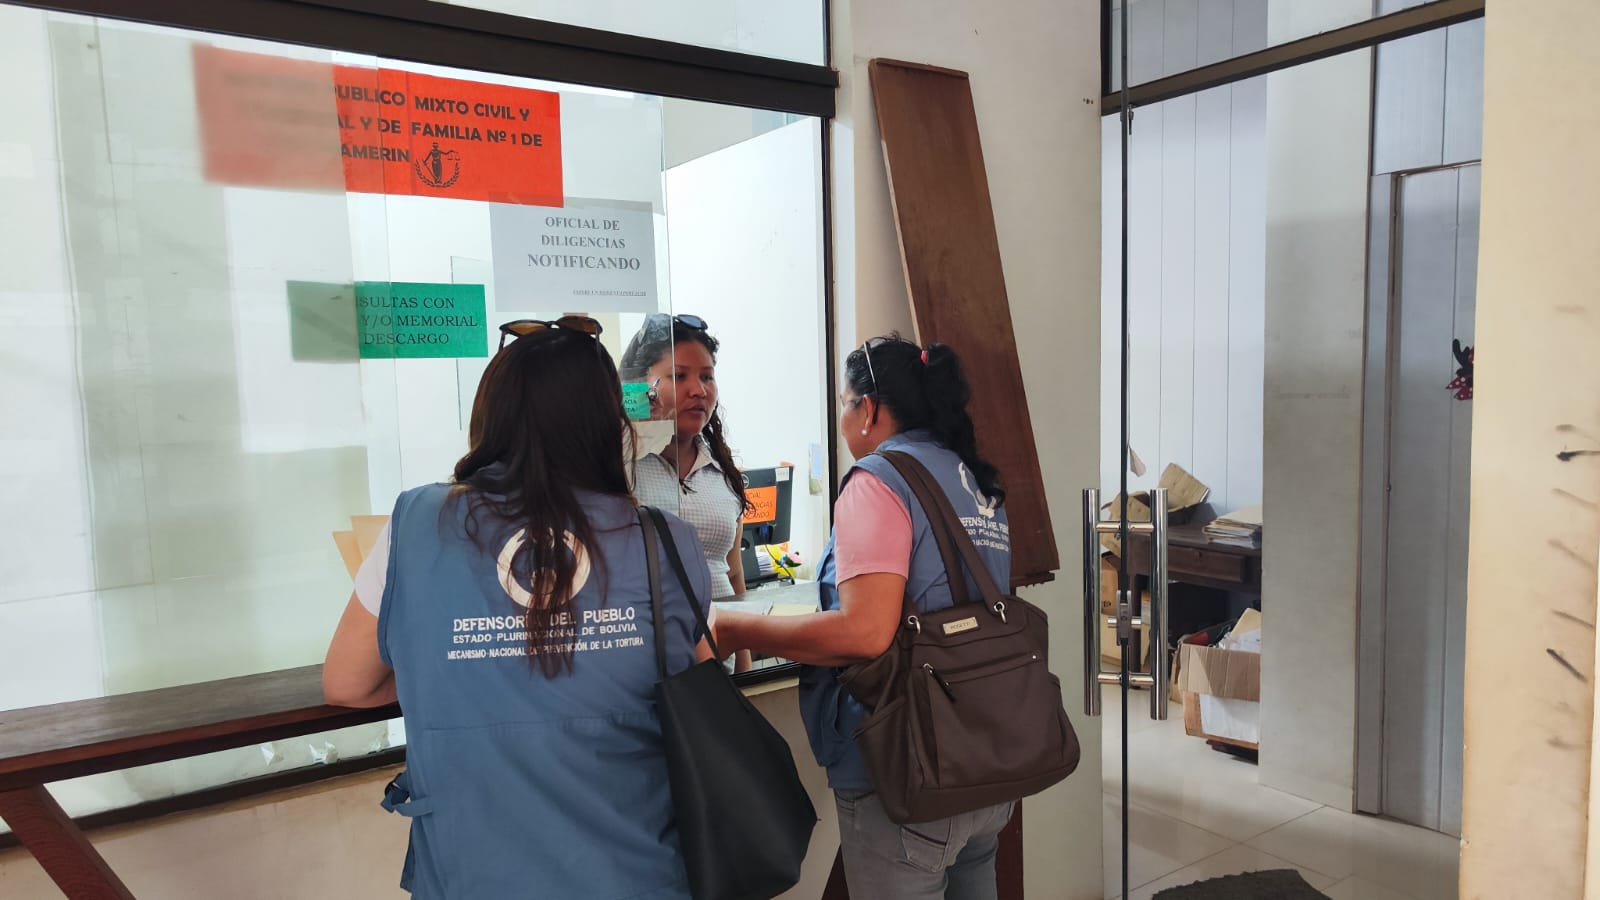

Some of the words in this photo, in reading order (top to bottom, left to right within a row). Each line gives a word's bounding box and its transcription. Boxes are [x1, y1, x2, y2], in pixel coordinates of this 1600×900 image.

[334, 85, 406, 106] UBLICO
[415, 96, 469, 115] MIXTO
[474, 103, 516, 120] CIVIL
[519, 108, 530, 122] Y
[360, 116, 373, 130] Y
[378, 118, 401, 134] DE
[411, 122, 482, 142] FAMILIA
[510, 134, 516, 145] 1
[521, 133, 543, 147] DE
[545, 216, 599, 230] OFICIAL
[603, 219, 621, 231] DE
[541, 234, 626, 249] DILIGENCIAS
[528, 253, 641, 271] NOTIFICANDO
[356, 295, 418, 309] SULTAS
[423, 296, 455, 309] CON
[362, 315, 392, 328] Y/O
[397, 315, 477, 327] MEMORIAL
[364, 333, 449, 345] DESCARGO
[453, 611, 543, 632] DEFENSORÍ
[549, 611, 577, 627] DEL
[583, 606, 635, 624] PUEBLO
[453, 633, 492, 644] ESTADO
[581, 626, 595, 636] DE
[599, 623, 637, 634] BOLIVIA
[447, 648, 487, 660] MECANISMO
[489, 646, 527, 658] NACIONAL
[590, 641, 600, 650] DE
[602, 640, 612, 649] LA
[615, 636, 644, 648] TORTURA
